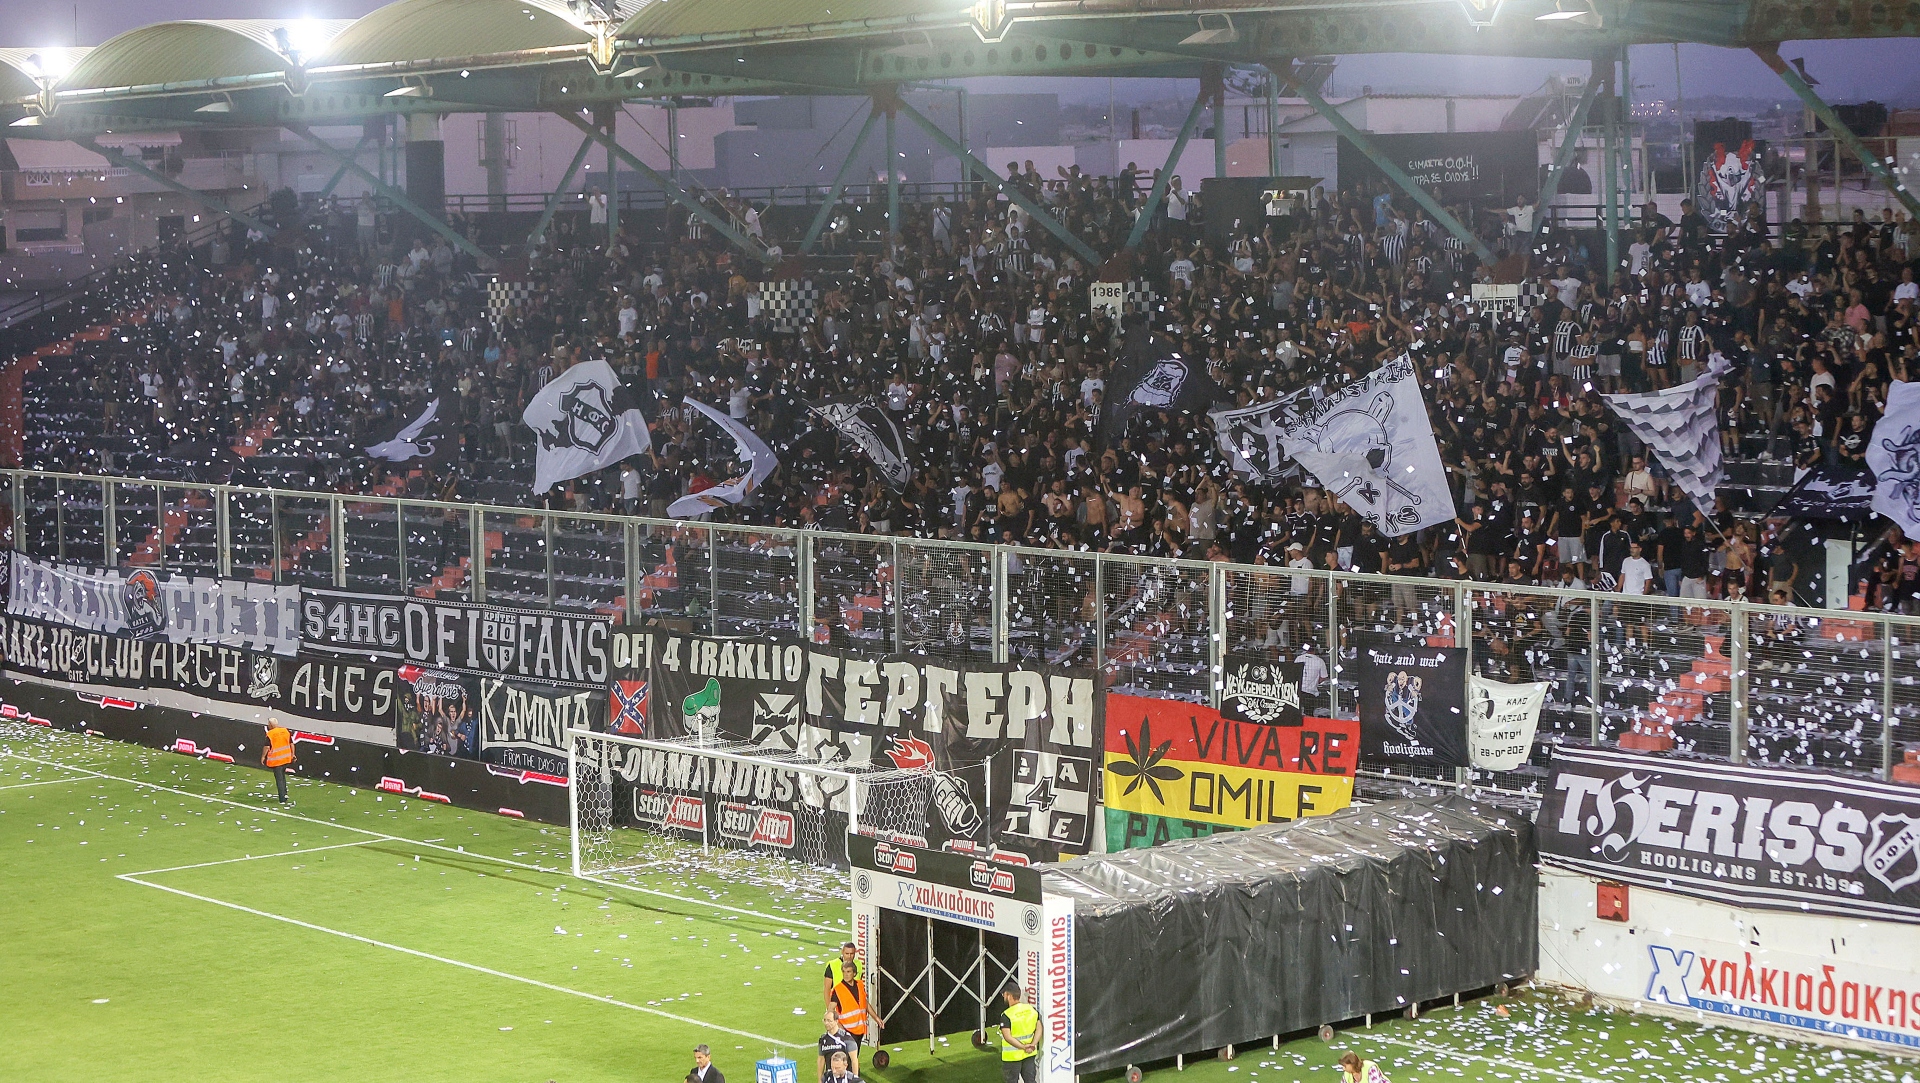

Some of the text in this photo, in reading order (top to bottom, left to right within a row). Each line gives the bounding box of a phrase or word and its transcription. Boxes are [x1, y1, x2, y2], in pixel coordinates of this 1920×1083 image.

[1091, 286, 1121, 298] 1986
[165, 576, 301, 657] CRETE
[304, 598, 400, 647] S4HC
[87, 633, 144, 680] CLUB
[404, 602, 608, 683] OFI FANS
[613, 633, 803, 682] OFI 4 IRAKLIO
[1394, 653, 1416, 666] and
[68, 669, 84, 682] GATE
[150, 643, 242, 694] ARCH
[1246, 680, 1299, 703] GENERATION
[805, 651, 1094, 748] ΓΕΡΓΕΡΗ
[522, 753, 536, 769] THE
[537, 756, 555, 773] DAYS
[1191, 716, 1284, 769] VIVA
[1640, 850, 1756, 881] HOOLIGANS
[1698, 1000, 1714, 1011] ΤΟ
[1779, 1013, 1806, 1027] ΠΟΥ
